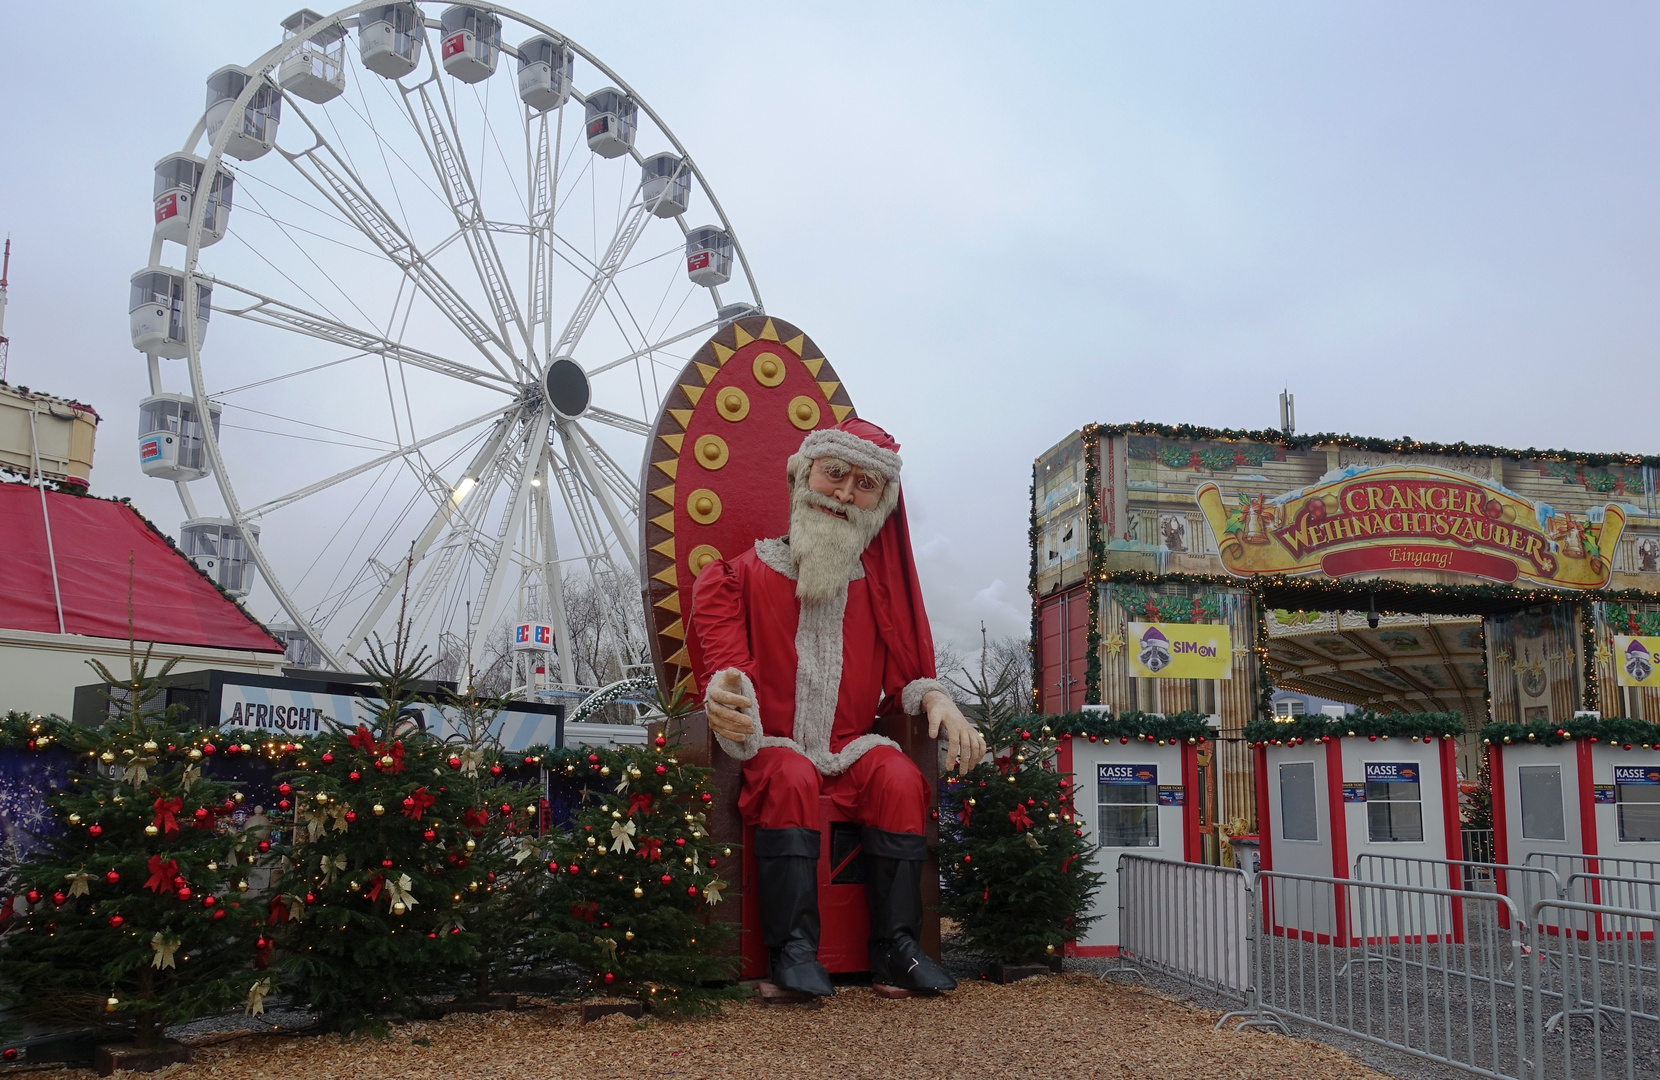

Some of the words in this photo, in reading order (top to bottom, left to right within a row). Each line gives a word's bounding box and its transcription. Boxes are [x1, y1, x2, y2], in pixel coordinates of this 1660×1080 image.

[1345, 485, 1484, 516] CRANGER
[1282, 512, 1544, 566] WEIHNACHTSZAUBER
[1389, 547, 1454, 568] Eingang!
[230, 701, 323, 731] AFRISCHT
[1099, 767, 1133, 777] KASSE
[1367, 765, 1397, 775] KASSE
[1616, 769, 1645, 778] KASSE
